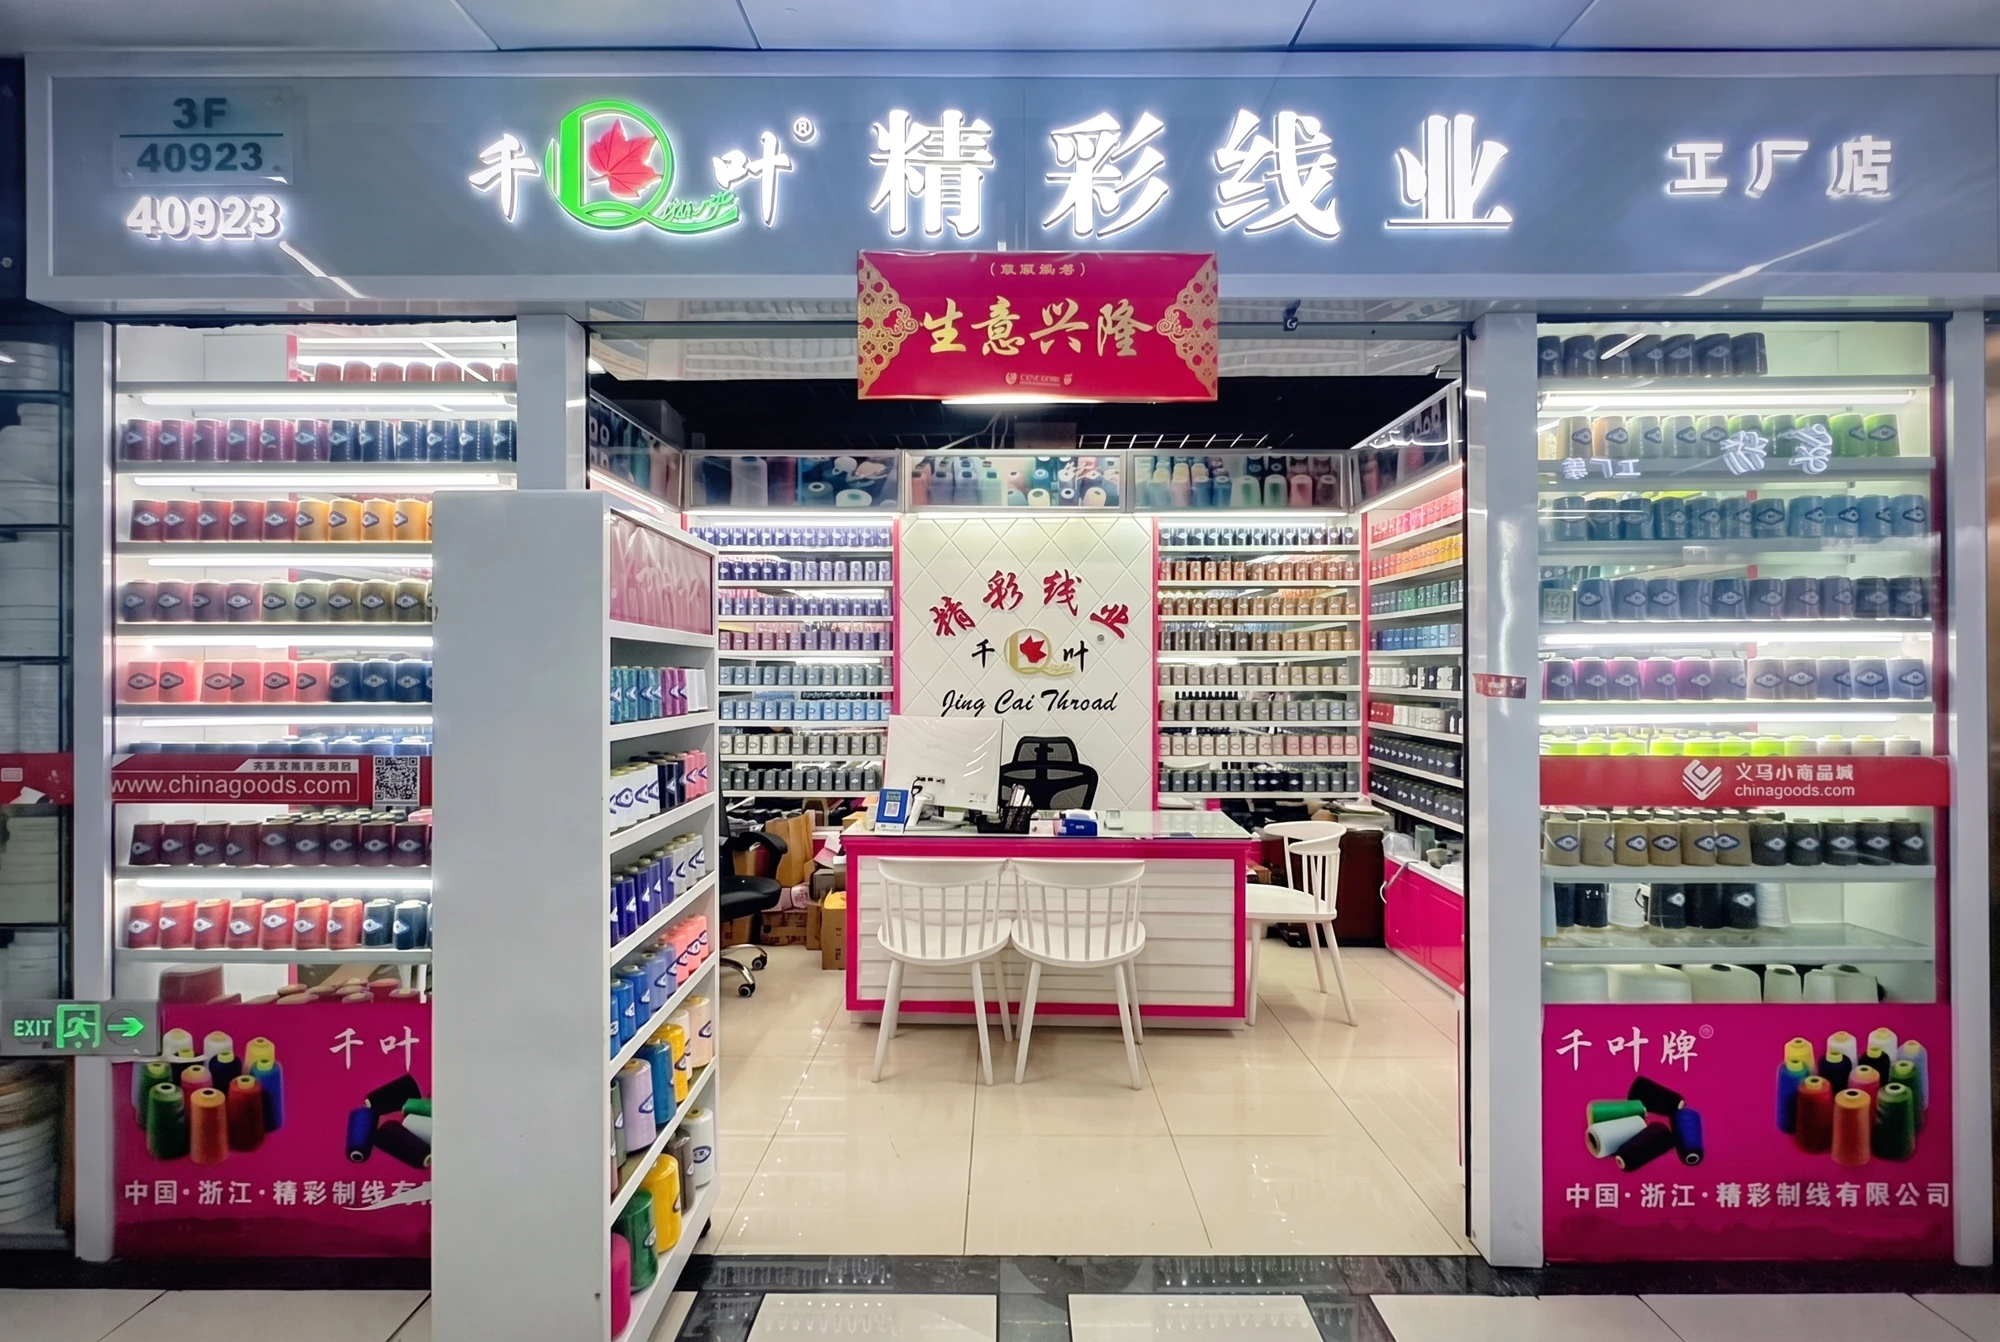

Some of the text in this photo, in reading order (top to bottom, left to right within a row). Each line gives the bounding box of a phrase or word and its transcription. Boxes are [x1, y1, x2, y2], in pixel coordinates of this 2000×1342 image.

[172, 97, 228, 129] 3F
[137, 142, 264, 172] 40923
[868, 108, 1513, 241] 精彩线业
[1664, 135, 1894, 199] 工厂店
[126, 196, 284, 241] 40923
[918, 295, 1153, 357] 生意兴隆
[929, 568, 1130, 640] 精彩线业
[940, 688, 1119, 718] Jing Cai Throad
[112, 774, 351, 799] www.chinagoods.com
[1734, 783, 1856, 800] chinagoods.com
[13, 1019, 52, 1037] EXIT
[329, 1026, 420, 1072] 千叶
[1555, 1026, 1699, 1073] 千叶牌
